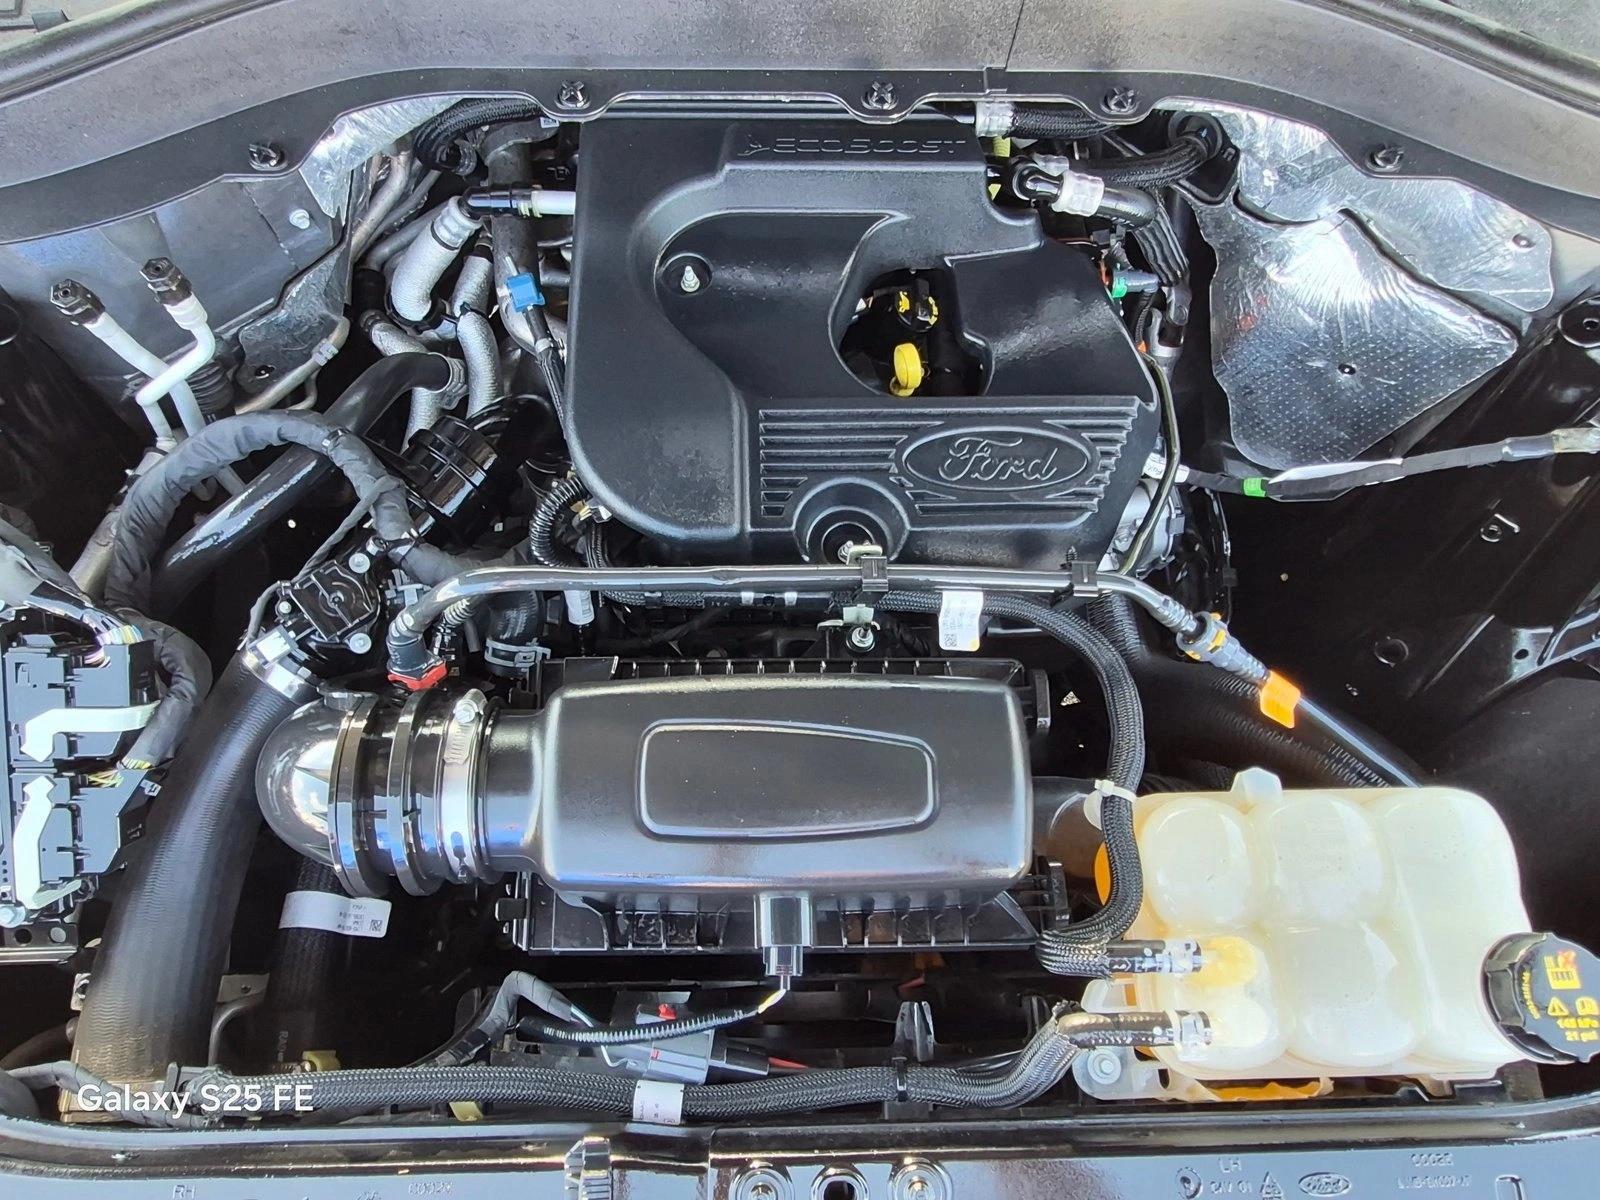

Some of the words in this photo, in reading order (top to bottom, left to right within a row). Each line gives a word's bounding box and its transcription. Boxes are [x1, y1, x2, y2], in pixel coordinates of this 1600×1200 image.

[938, 436, 1058, 482] Ford
[1218, 1157, 1242, 1174] LH
[172, 1184, 196, 1200] RH
